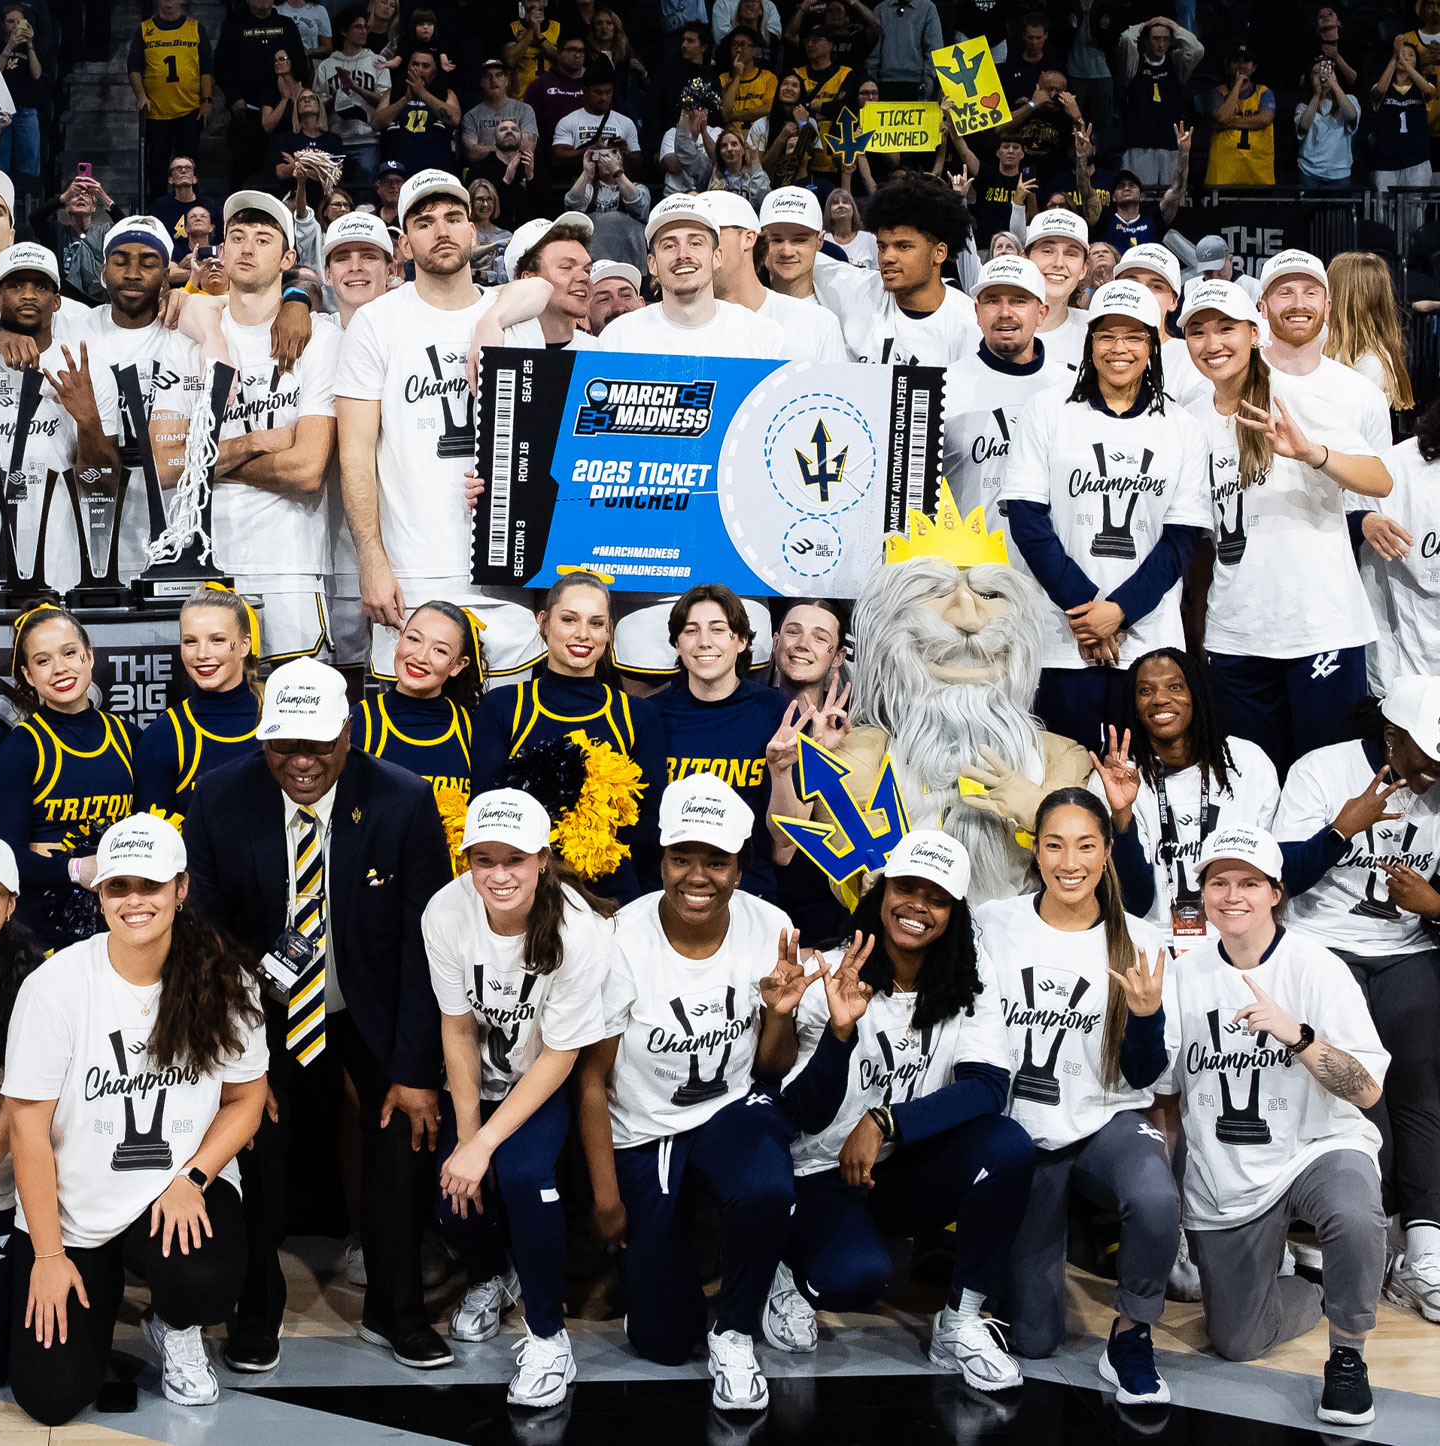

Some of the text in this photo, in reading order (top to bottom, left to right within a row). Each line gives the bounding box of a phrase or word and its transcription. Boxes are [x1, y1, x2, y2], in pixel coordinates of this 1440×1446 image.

[163, 55, 180, 83] 1
[877, 109, 925, 126] TICKET
[951, 102, 979, 119] WE
[955, 108, 1002, 134] UCSD
[871, 131, 928, 147] PUNCHED
[772, 197, 807, 211] Champions
[337, 221, 375, 233] Champions
[1042, 216, 1077, 229] Champions
[1221, 226, 1284, 255] THE
[988, 262, 1024, 275] Champions
[1103, 290, 1141, 303] Champions
[1192, 288, 1229, 302] Champions
[183, 376, 199, 384] BIG
[183, 384, 205, 392] WEST
[522, 360, 533, 402] SEAT 25
[608, 384, 678, 406] MARCH
[895, 375, 908, 431] QUALIFIER
[417, 418, 436, 429] 24
[615, 406, 709, 429] MADNESS
[518, 457, 528, 482] ROW
[892, 432, 905, 493] AUTOMATIC
[572, 459, 712, 487] 2025 TICKET
[983, 476, 1001, 489] 24
[1068, 468, 1167, 499] Champions
[590, 485, 690, 511] PUNCHED
[1076, 513, 1094, 525] 24
[514, 520, 526, 577] SECTION 3
[592, 545, 681, 559] #MARCHMADNESS
[108, 653, 173, 682] THE
[110, 684, 167, 712] BIG
[275, 690, 321, 708] Champions
[667, 758, 766, 786] RITONS
[478, 807, 524, 822] Champions
[681, 800, 726, 818] Champions
[109, 837, 155, 853] Champions
[1213, 834, 1259, 848] Champions
[910, 843, 955, 868] Champions
[273, 950, 283, 960] ALL
[281, 956, 299, 972] ACCESS
[1186, 1041, 1295, 1078] Champions
[654, 1067, 677, 1080] 24
[1063, 1060, 1083, 1077] 25
[85, 1065, 200, 1101] Champions
[1198, 1092, 1215, 1107] 24
[1267, 1098, 1289, 1111] 25
[94, 1119, 114, 1135] 24
[171, 1119, 193, 1133] 25
